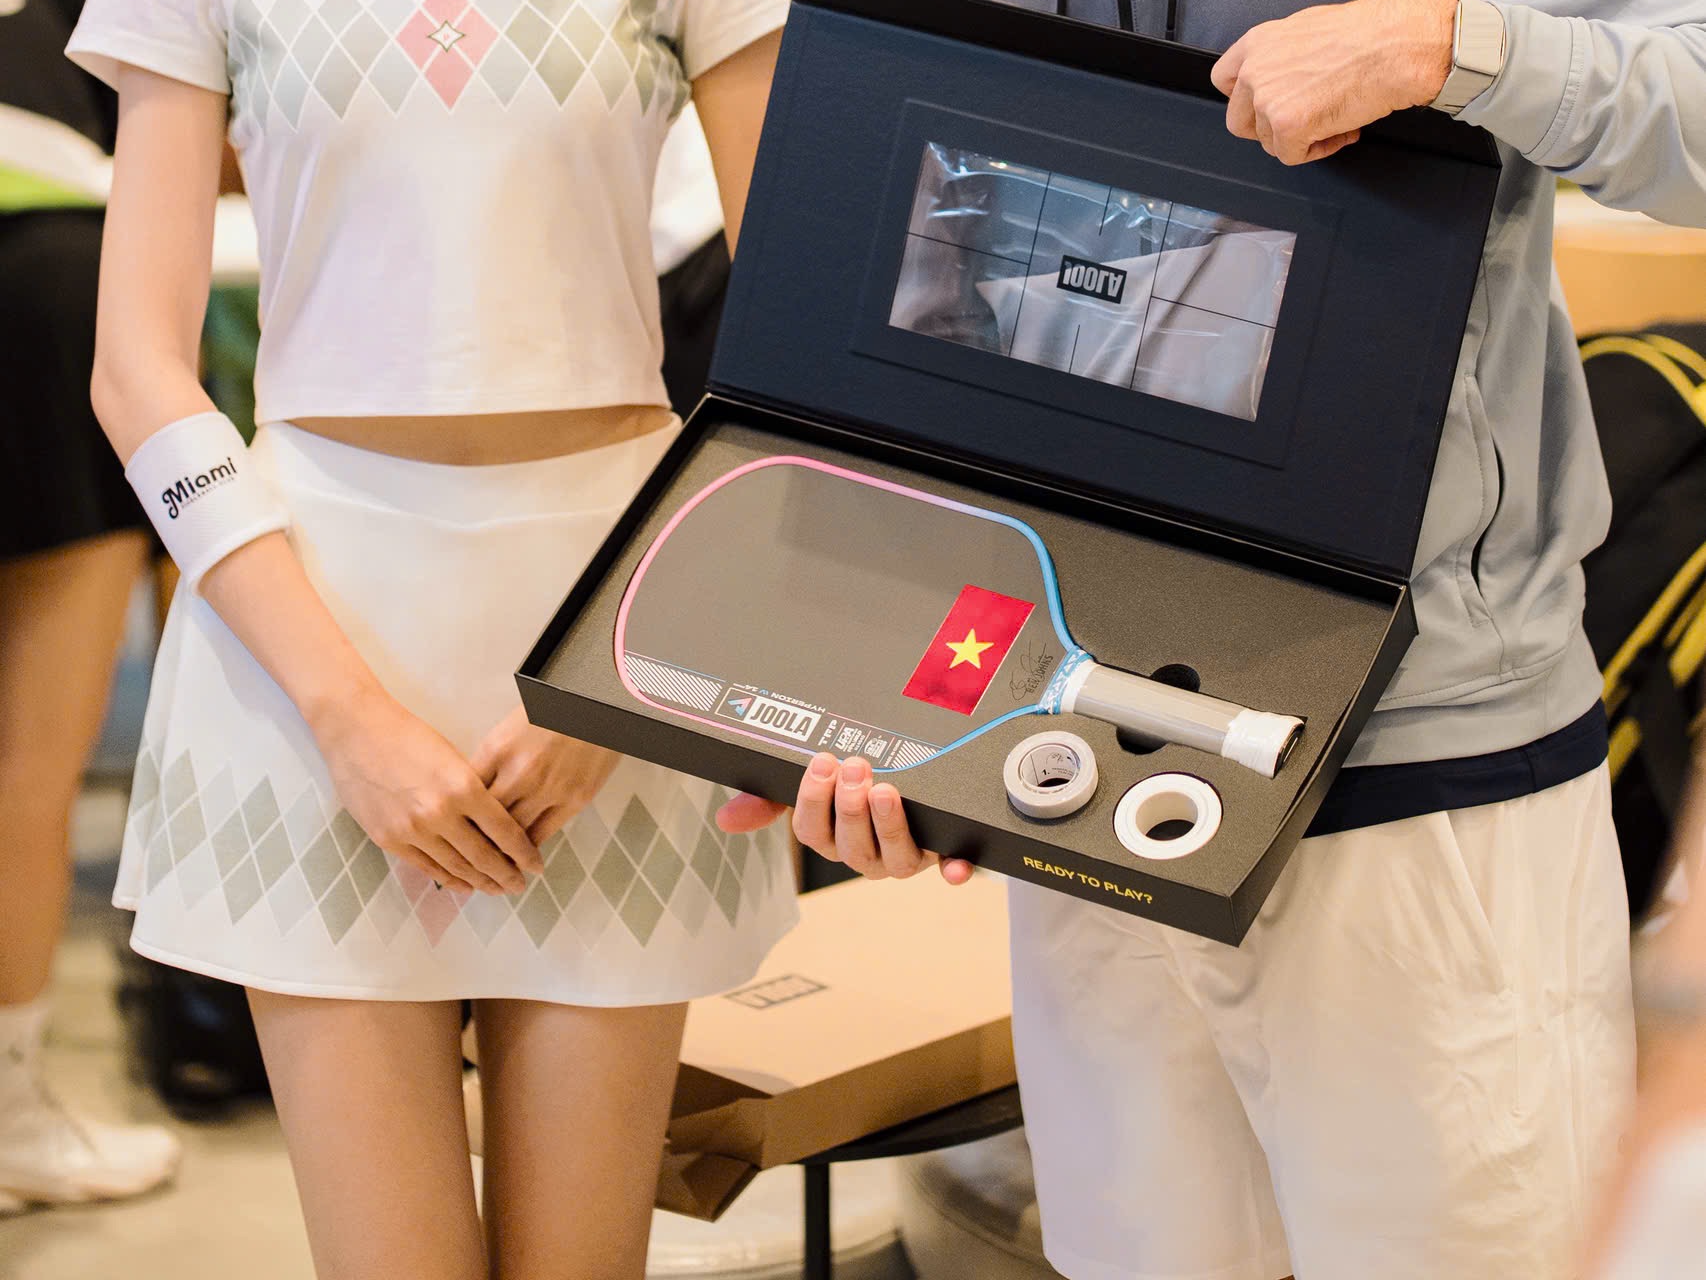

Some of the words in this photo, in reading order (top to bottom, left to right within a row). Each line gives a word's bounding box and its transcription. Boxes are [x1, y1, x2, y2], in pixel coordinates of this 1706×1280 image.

[162, 456, 237, 520] Miami
[1034, 654, 1054, 680] JOHNS
[750, 702, 814, 737] JOOLA
[770, 692, 827, 714] HYPERION
[1023, 856, 1075, 880] READY
[1077, 872, 1101, 888] TO
[1103, 881, 1153, 904] PLAY?
